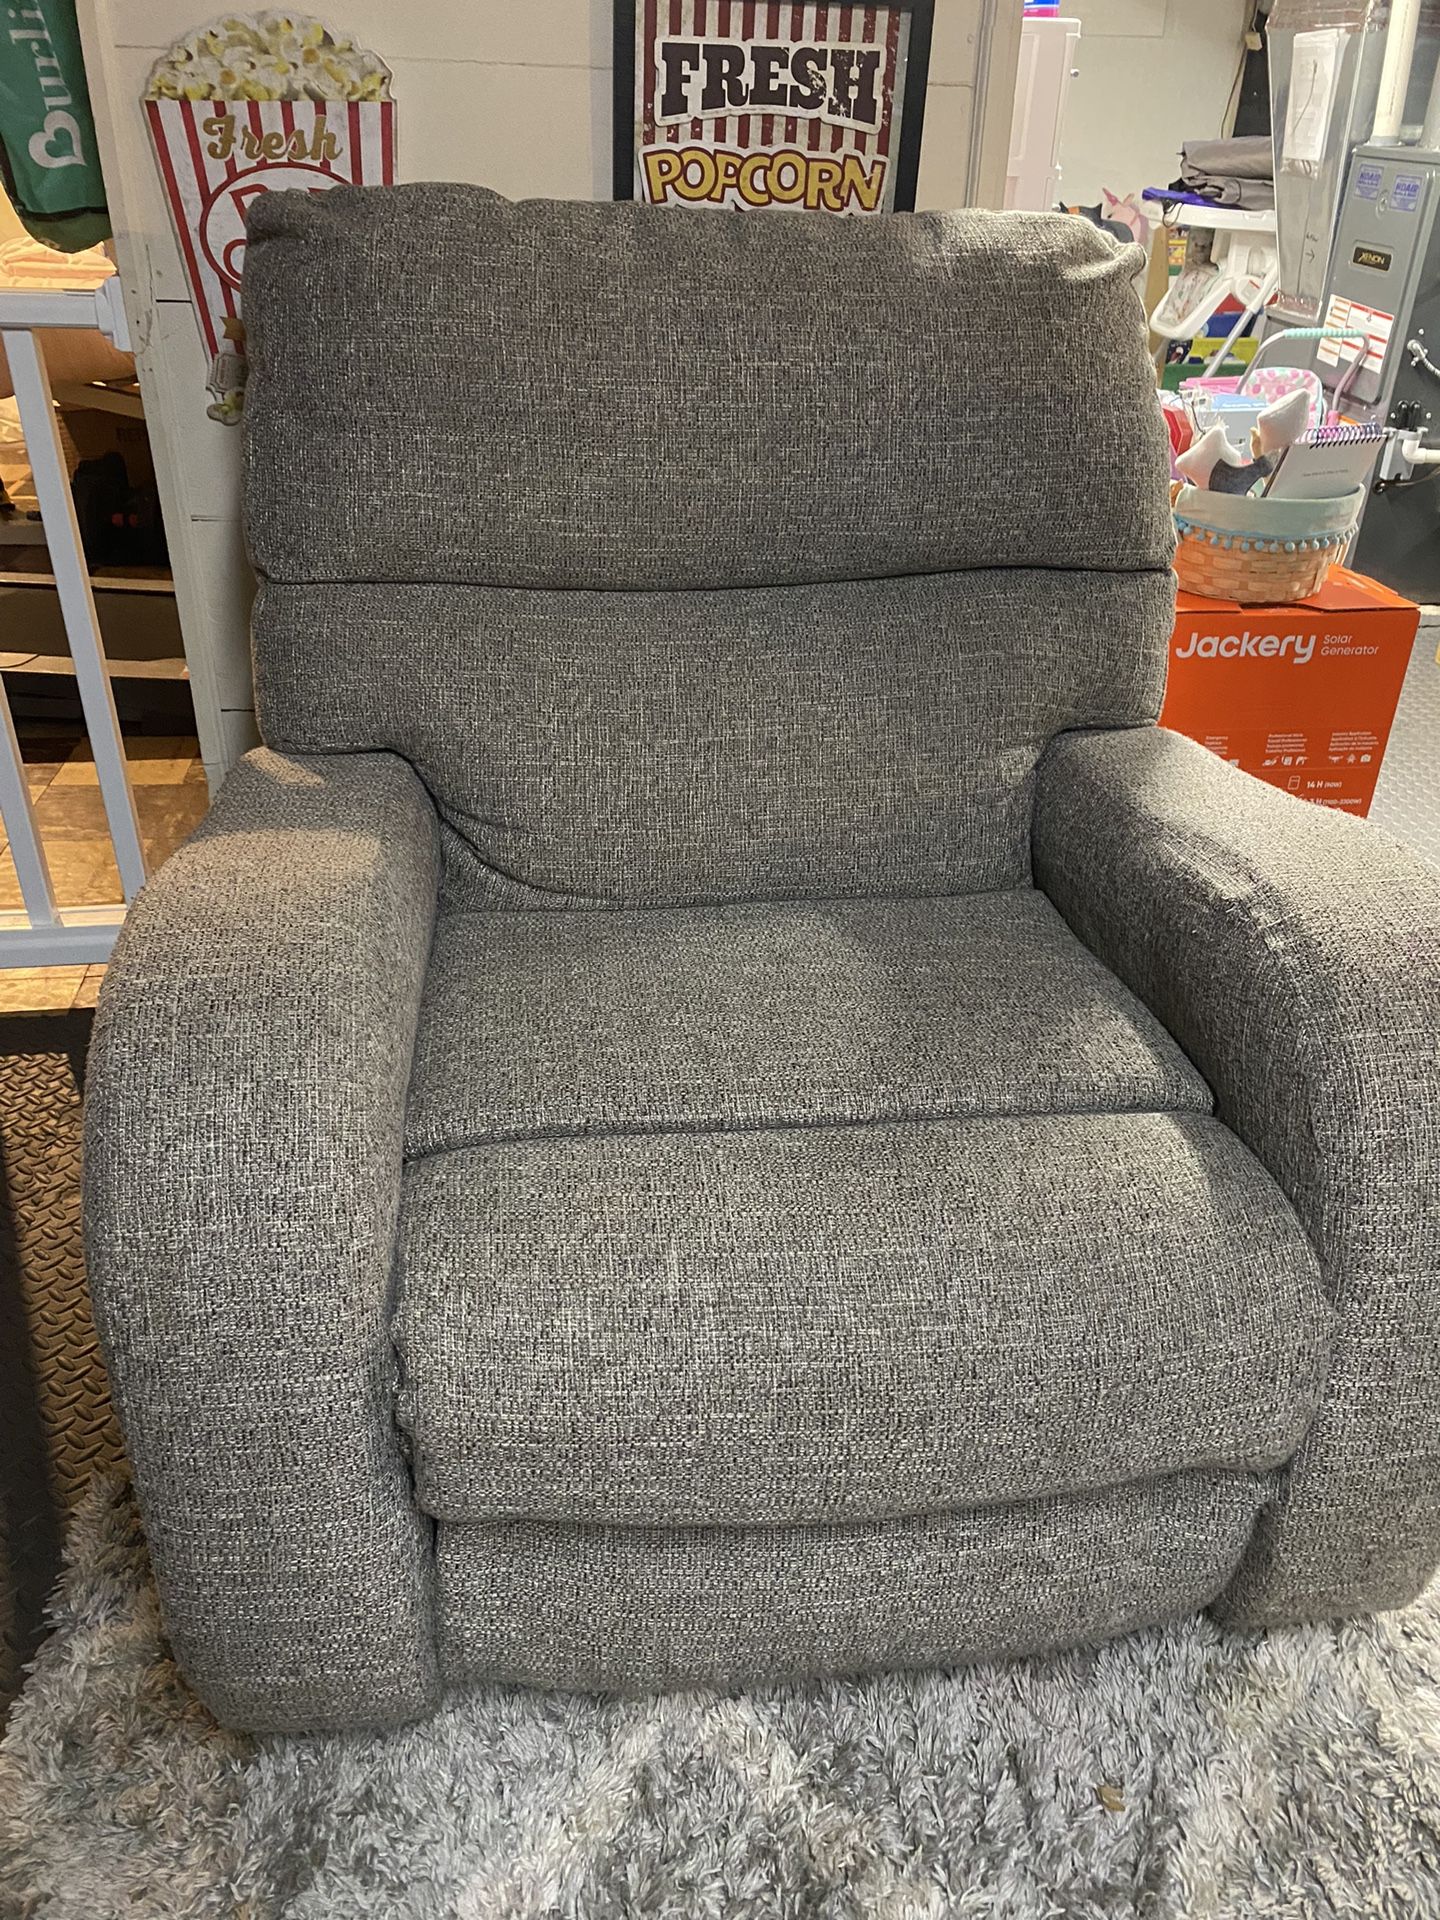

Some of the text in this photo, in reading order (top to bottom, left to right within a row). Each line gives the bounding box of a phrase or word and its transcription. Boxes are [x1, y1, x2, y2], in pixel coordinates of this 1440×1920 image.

[8, 0, 87, 169] Burli
[660, 42, 881, 125] FRESH
[202, 114, 343, 160] Fresh
[643, 146, 887, 213] POPCORN
[1357, 251, 1385, 265] XENON
[1175, 631, 1317, 665] Jackery
[1320, 645, 1380, 656] Generator
[1323, 634, 1353, 645] Solar
[1306, 780, 1316, 789] 14
[1316, 780, 1324, 788] H
